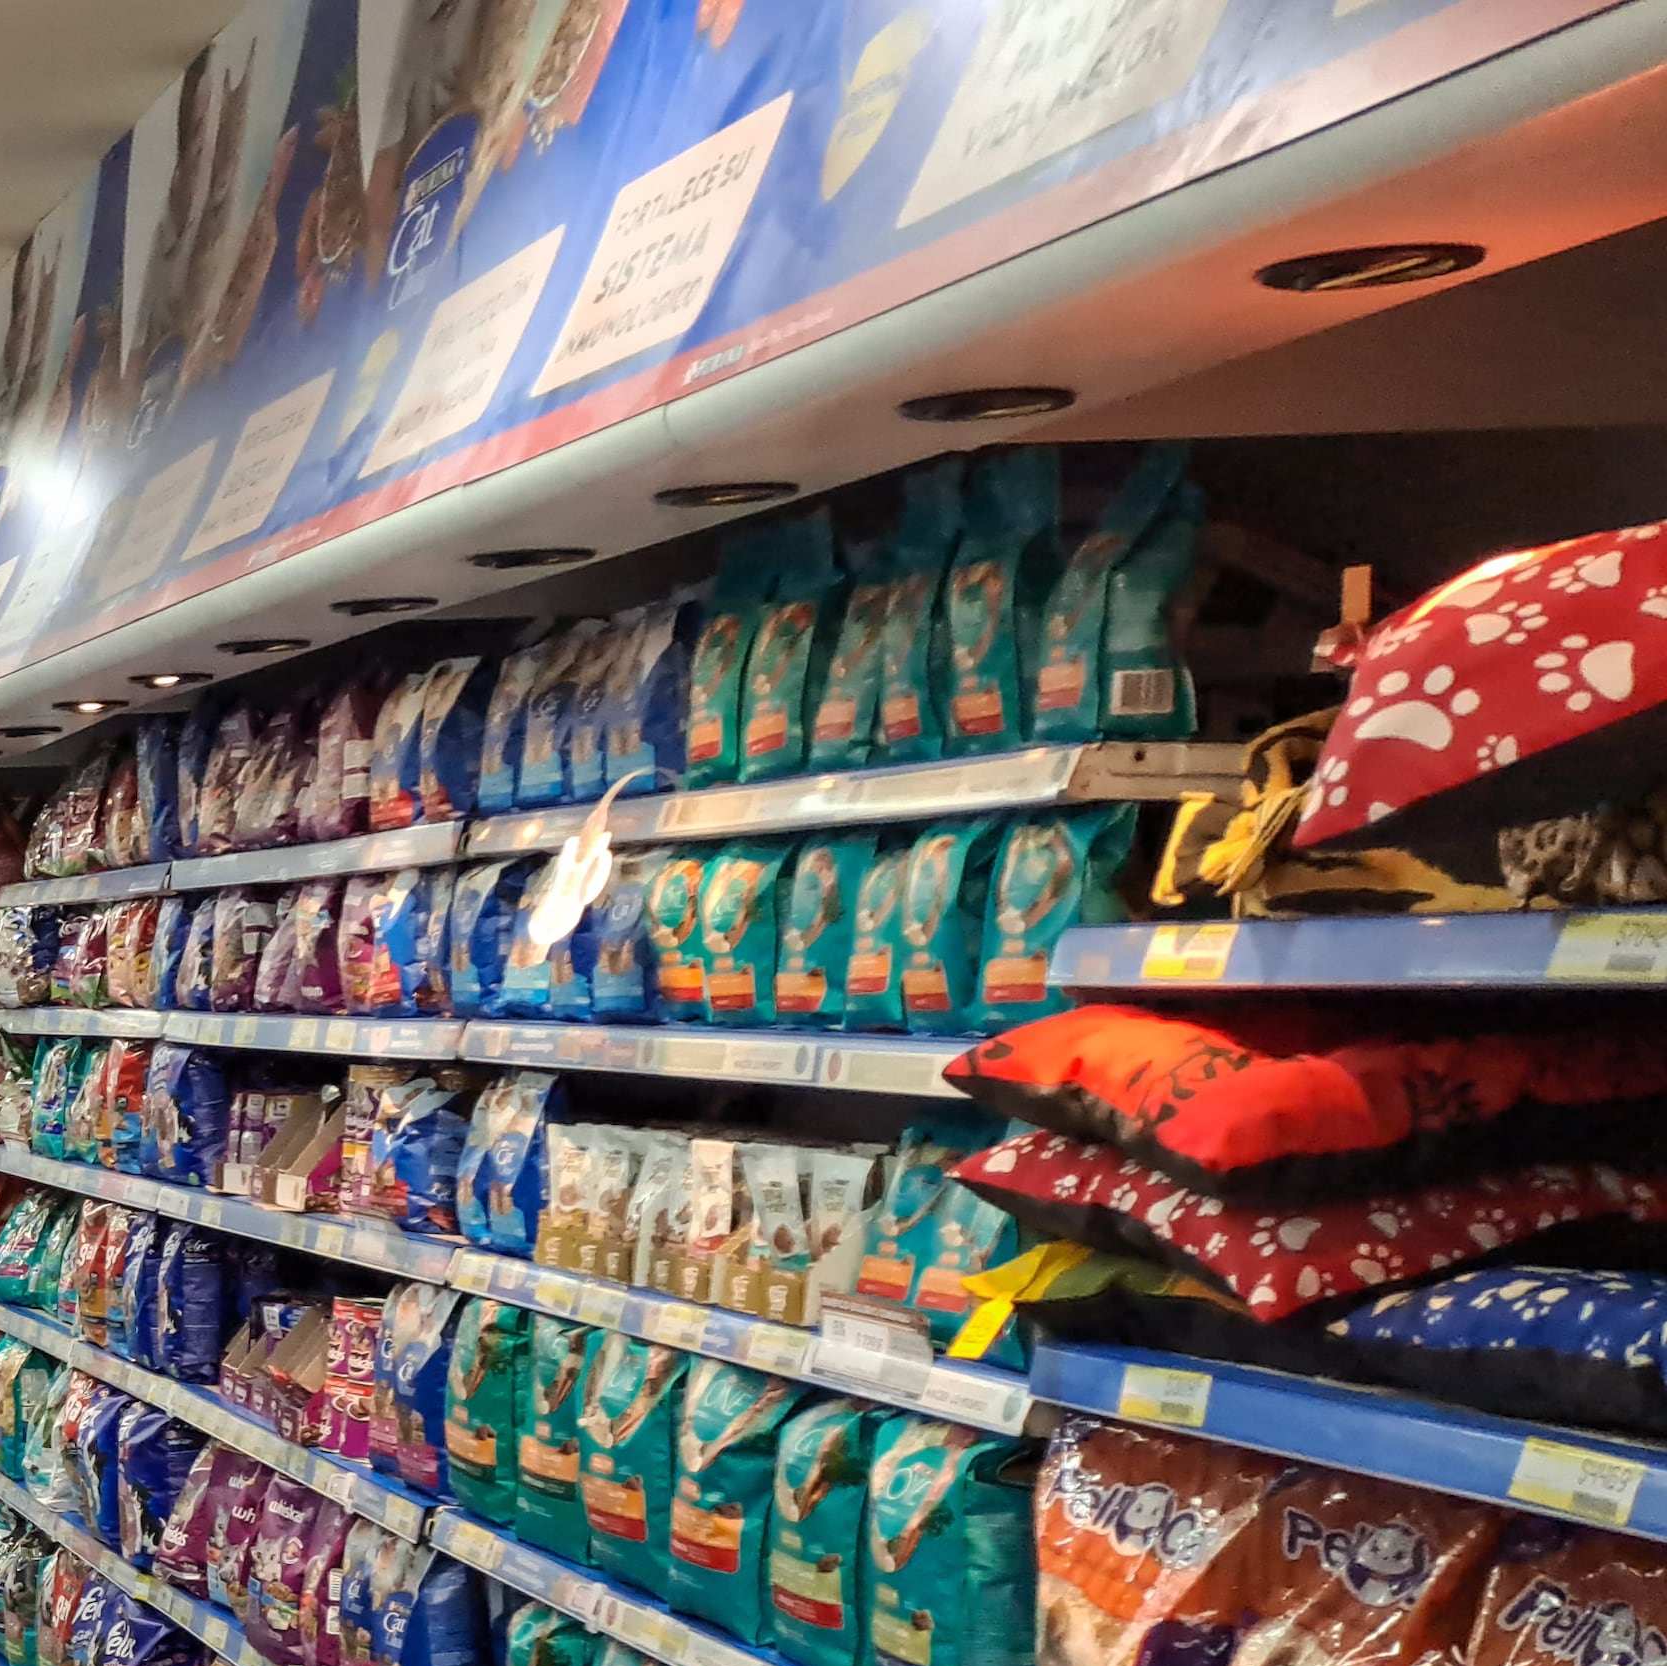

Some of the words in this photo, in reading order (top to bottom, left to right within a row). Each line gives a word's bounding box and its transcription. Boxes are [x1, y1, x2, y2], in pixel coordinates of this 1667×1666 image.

[617, 168, 718, 238] FORTALECÉ
[720, 147, 757, 187] SU
[389, 200, 434, 278] Cat
[594, 219, 712, 303] SISTEMA
